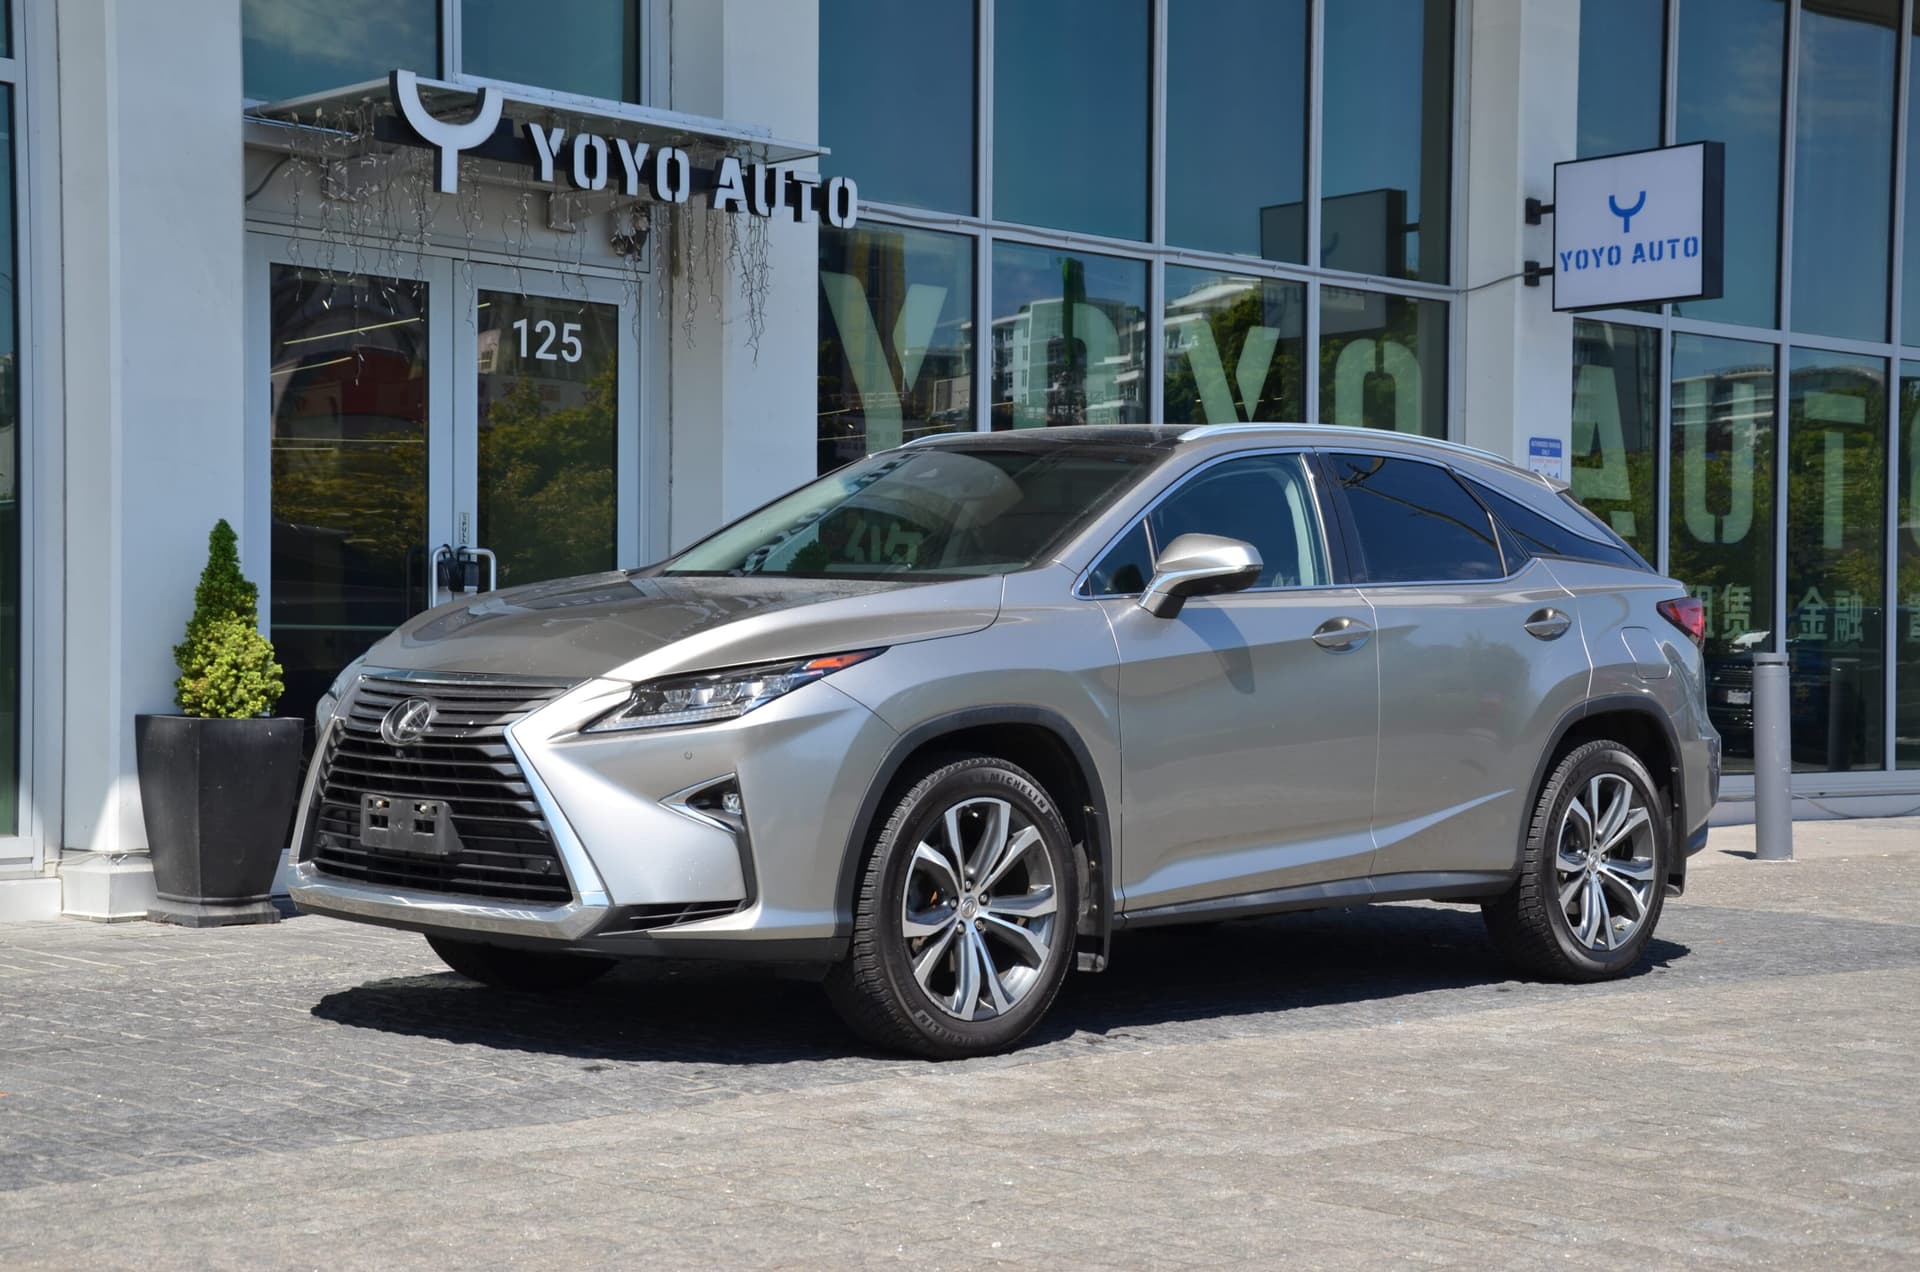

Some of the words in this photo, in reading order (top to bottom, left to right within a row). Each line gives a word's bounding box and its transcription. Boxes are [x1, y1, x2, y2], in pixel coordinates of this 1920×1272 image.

[522, 122, 690, 203] YOYO
[713, 155, 858, 229] AUTO
[1560, 245, 1621, 272] YOYO
[1632, 236, 1698, 264] AUTO
[513, 318, 583, 363] 125
[1571, 364, 1920, 550] AUT
[991, 773, 1047, 809] MICHELIN
